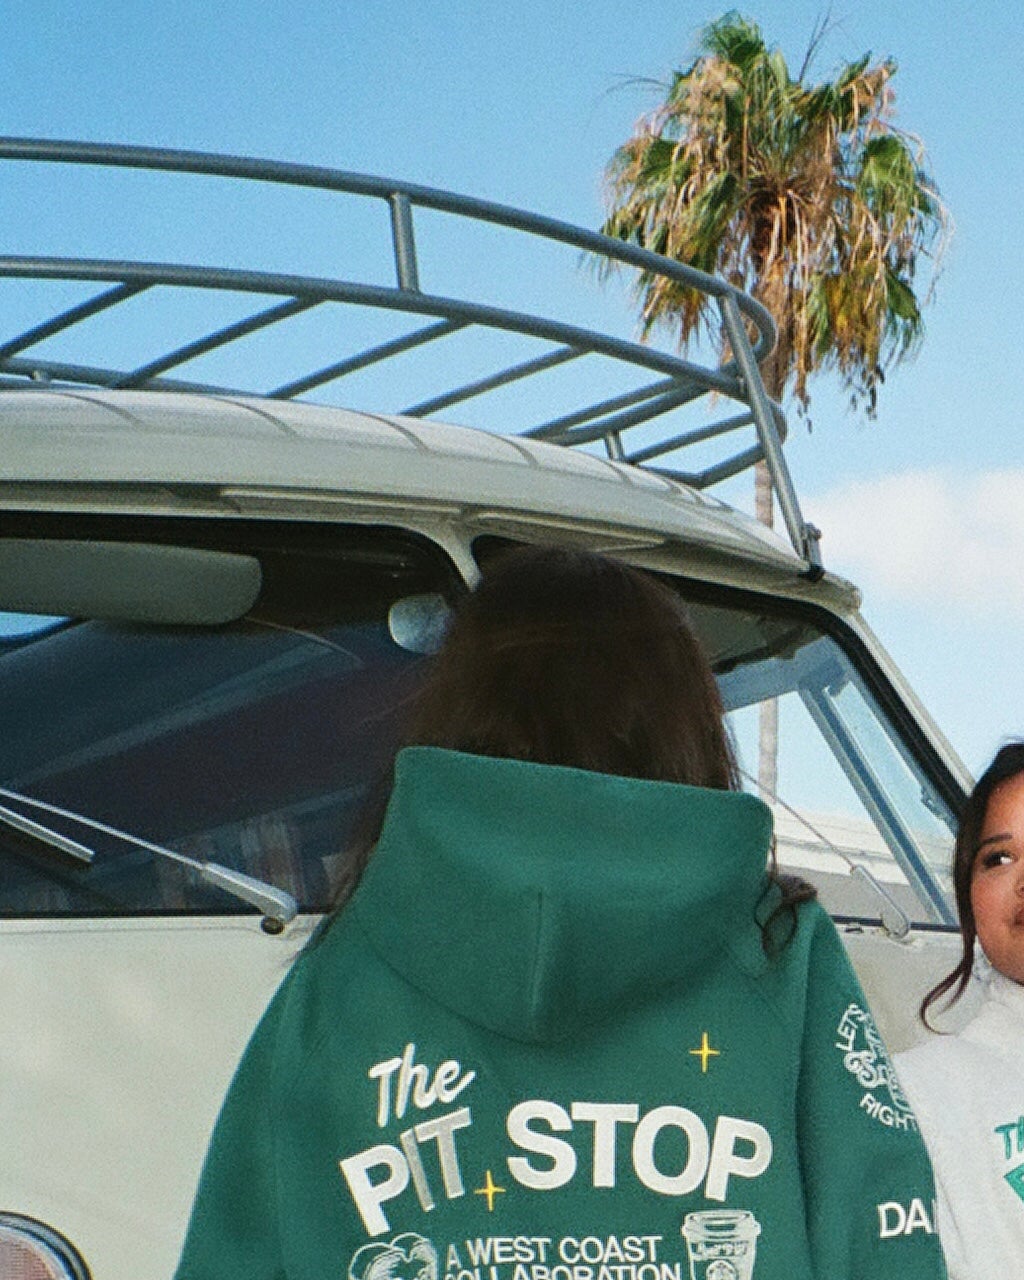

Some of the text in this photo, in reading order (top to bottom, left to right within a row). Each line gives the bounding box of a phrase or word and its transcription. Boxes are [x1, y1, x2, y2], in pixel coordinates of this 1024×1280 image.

[369, 1043, 475, 1127] The
[339, 1100, 773, 1237] PIT STOP
[876, 1199, 938, 1239] DA
[446, 1243, 462, 1272] A
[466, 1237, 551, 1266] WEST
[558, 1236, 662, 1264] COAST
